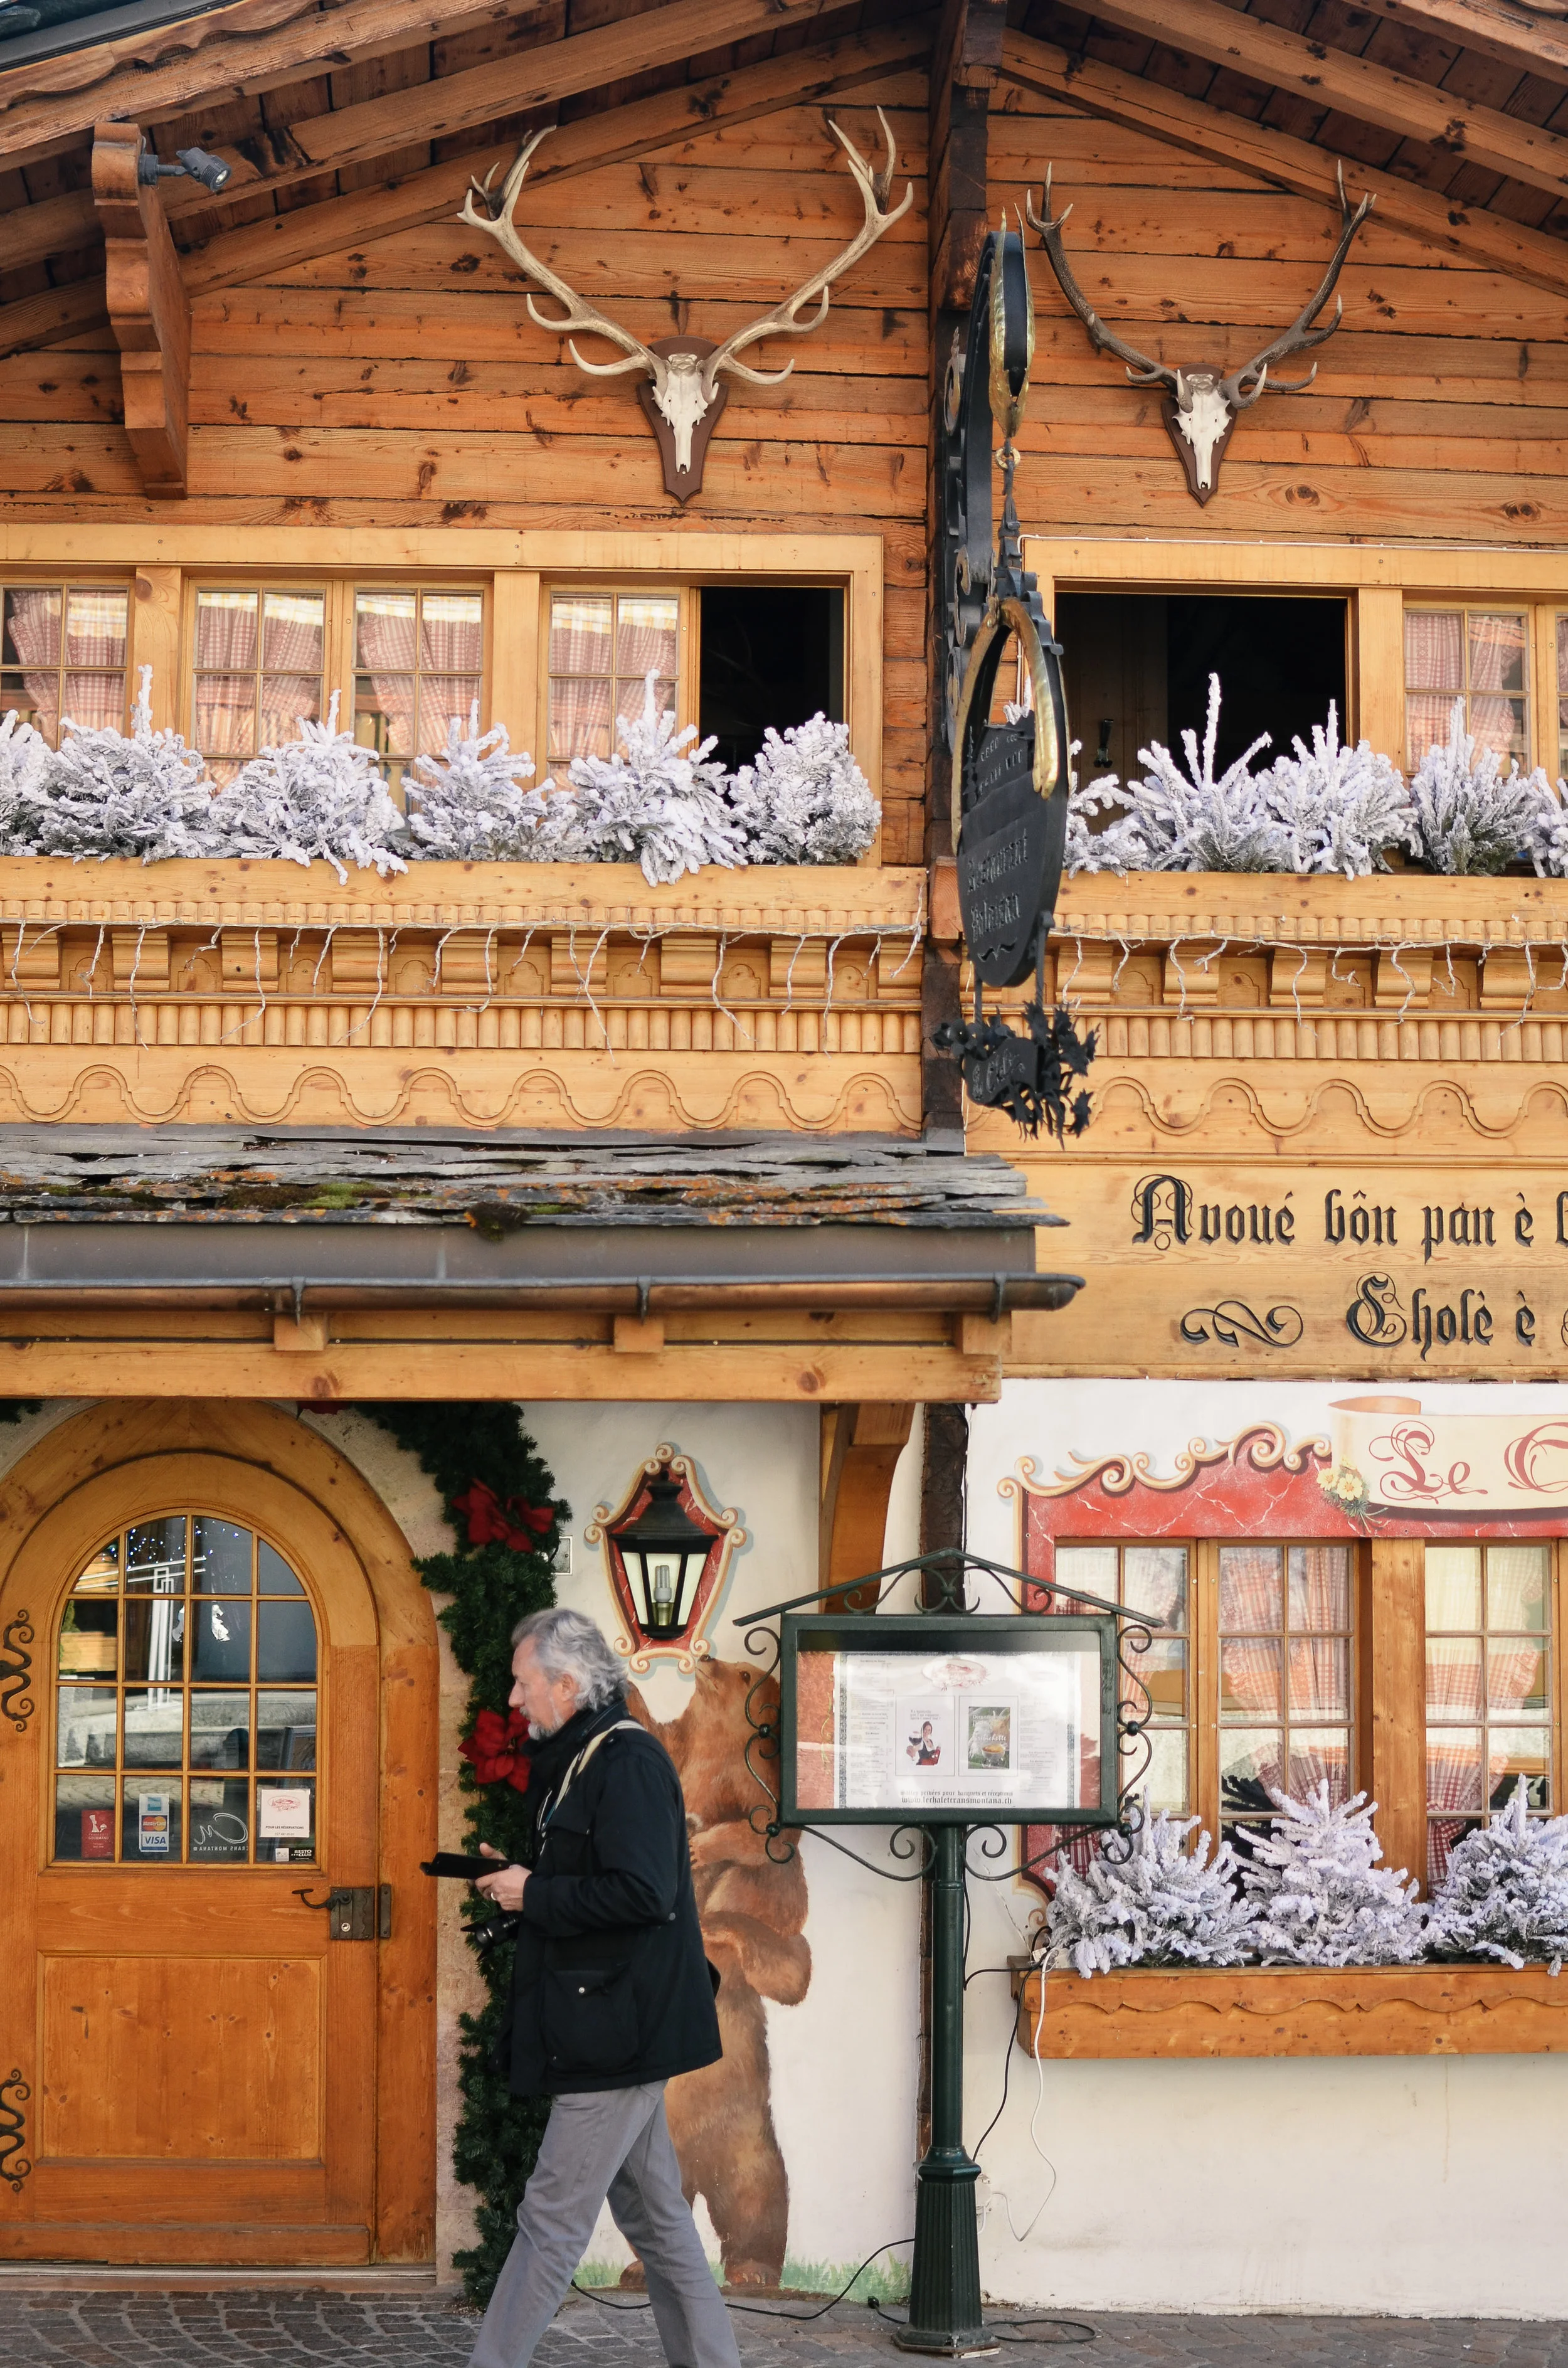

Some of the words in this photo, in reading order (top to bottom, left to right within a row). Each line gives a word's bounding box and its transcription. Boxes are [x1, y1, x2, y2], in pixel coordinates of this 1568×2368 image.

[1515, 1192, 1534, 1247] è
[1515, 1290, 1535, 1347] è
[1369, 1420, 1488, 1504] Le
[145, 1836, 166, 1844] VISA
